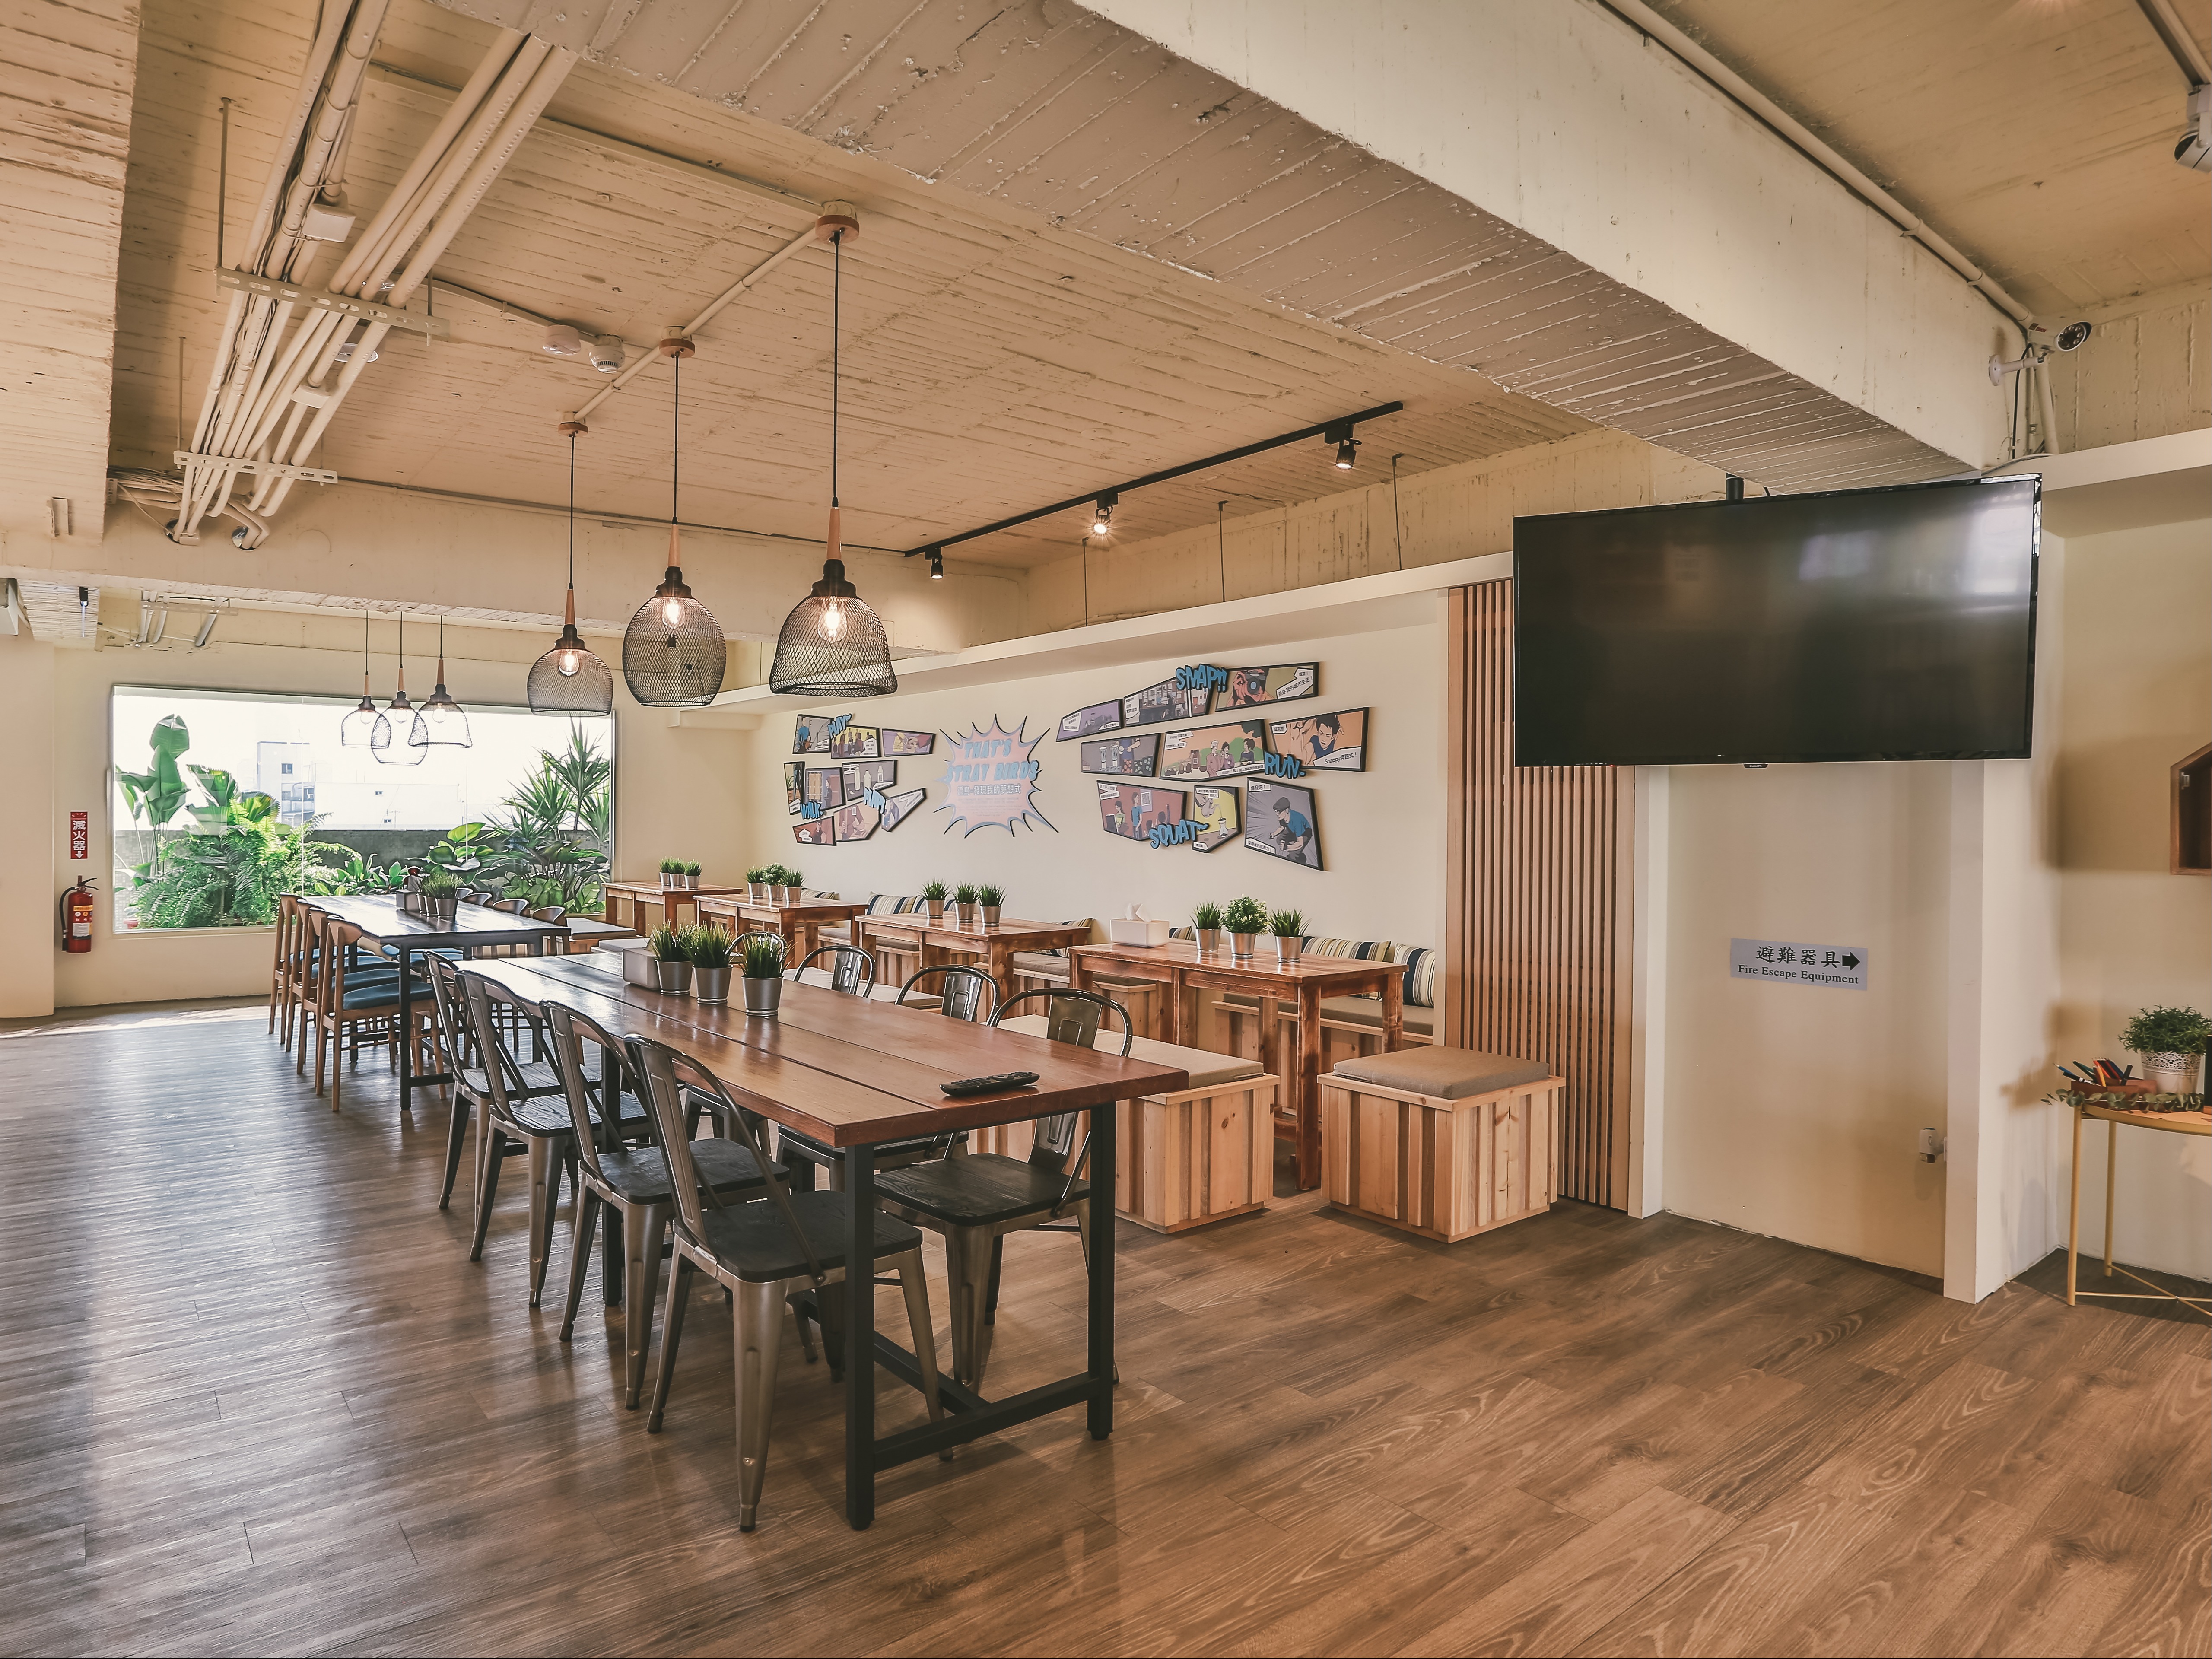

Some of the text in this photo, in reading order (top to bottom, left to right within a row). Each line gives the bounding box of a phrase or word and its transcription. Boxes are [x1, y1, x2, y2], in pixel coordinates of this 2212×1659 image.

[964, 738, 1012, 759] THAT'S
[946, 760, 1039, 783] STRAY BIRDS
[73, 820, 86, 850] 滅火器
[1755, 946, 1841, 968] 避難器具
[1738, 964, 1859, 984] Fire Escape Equipment
